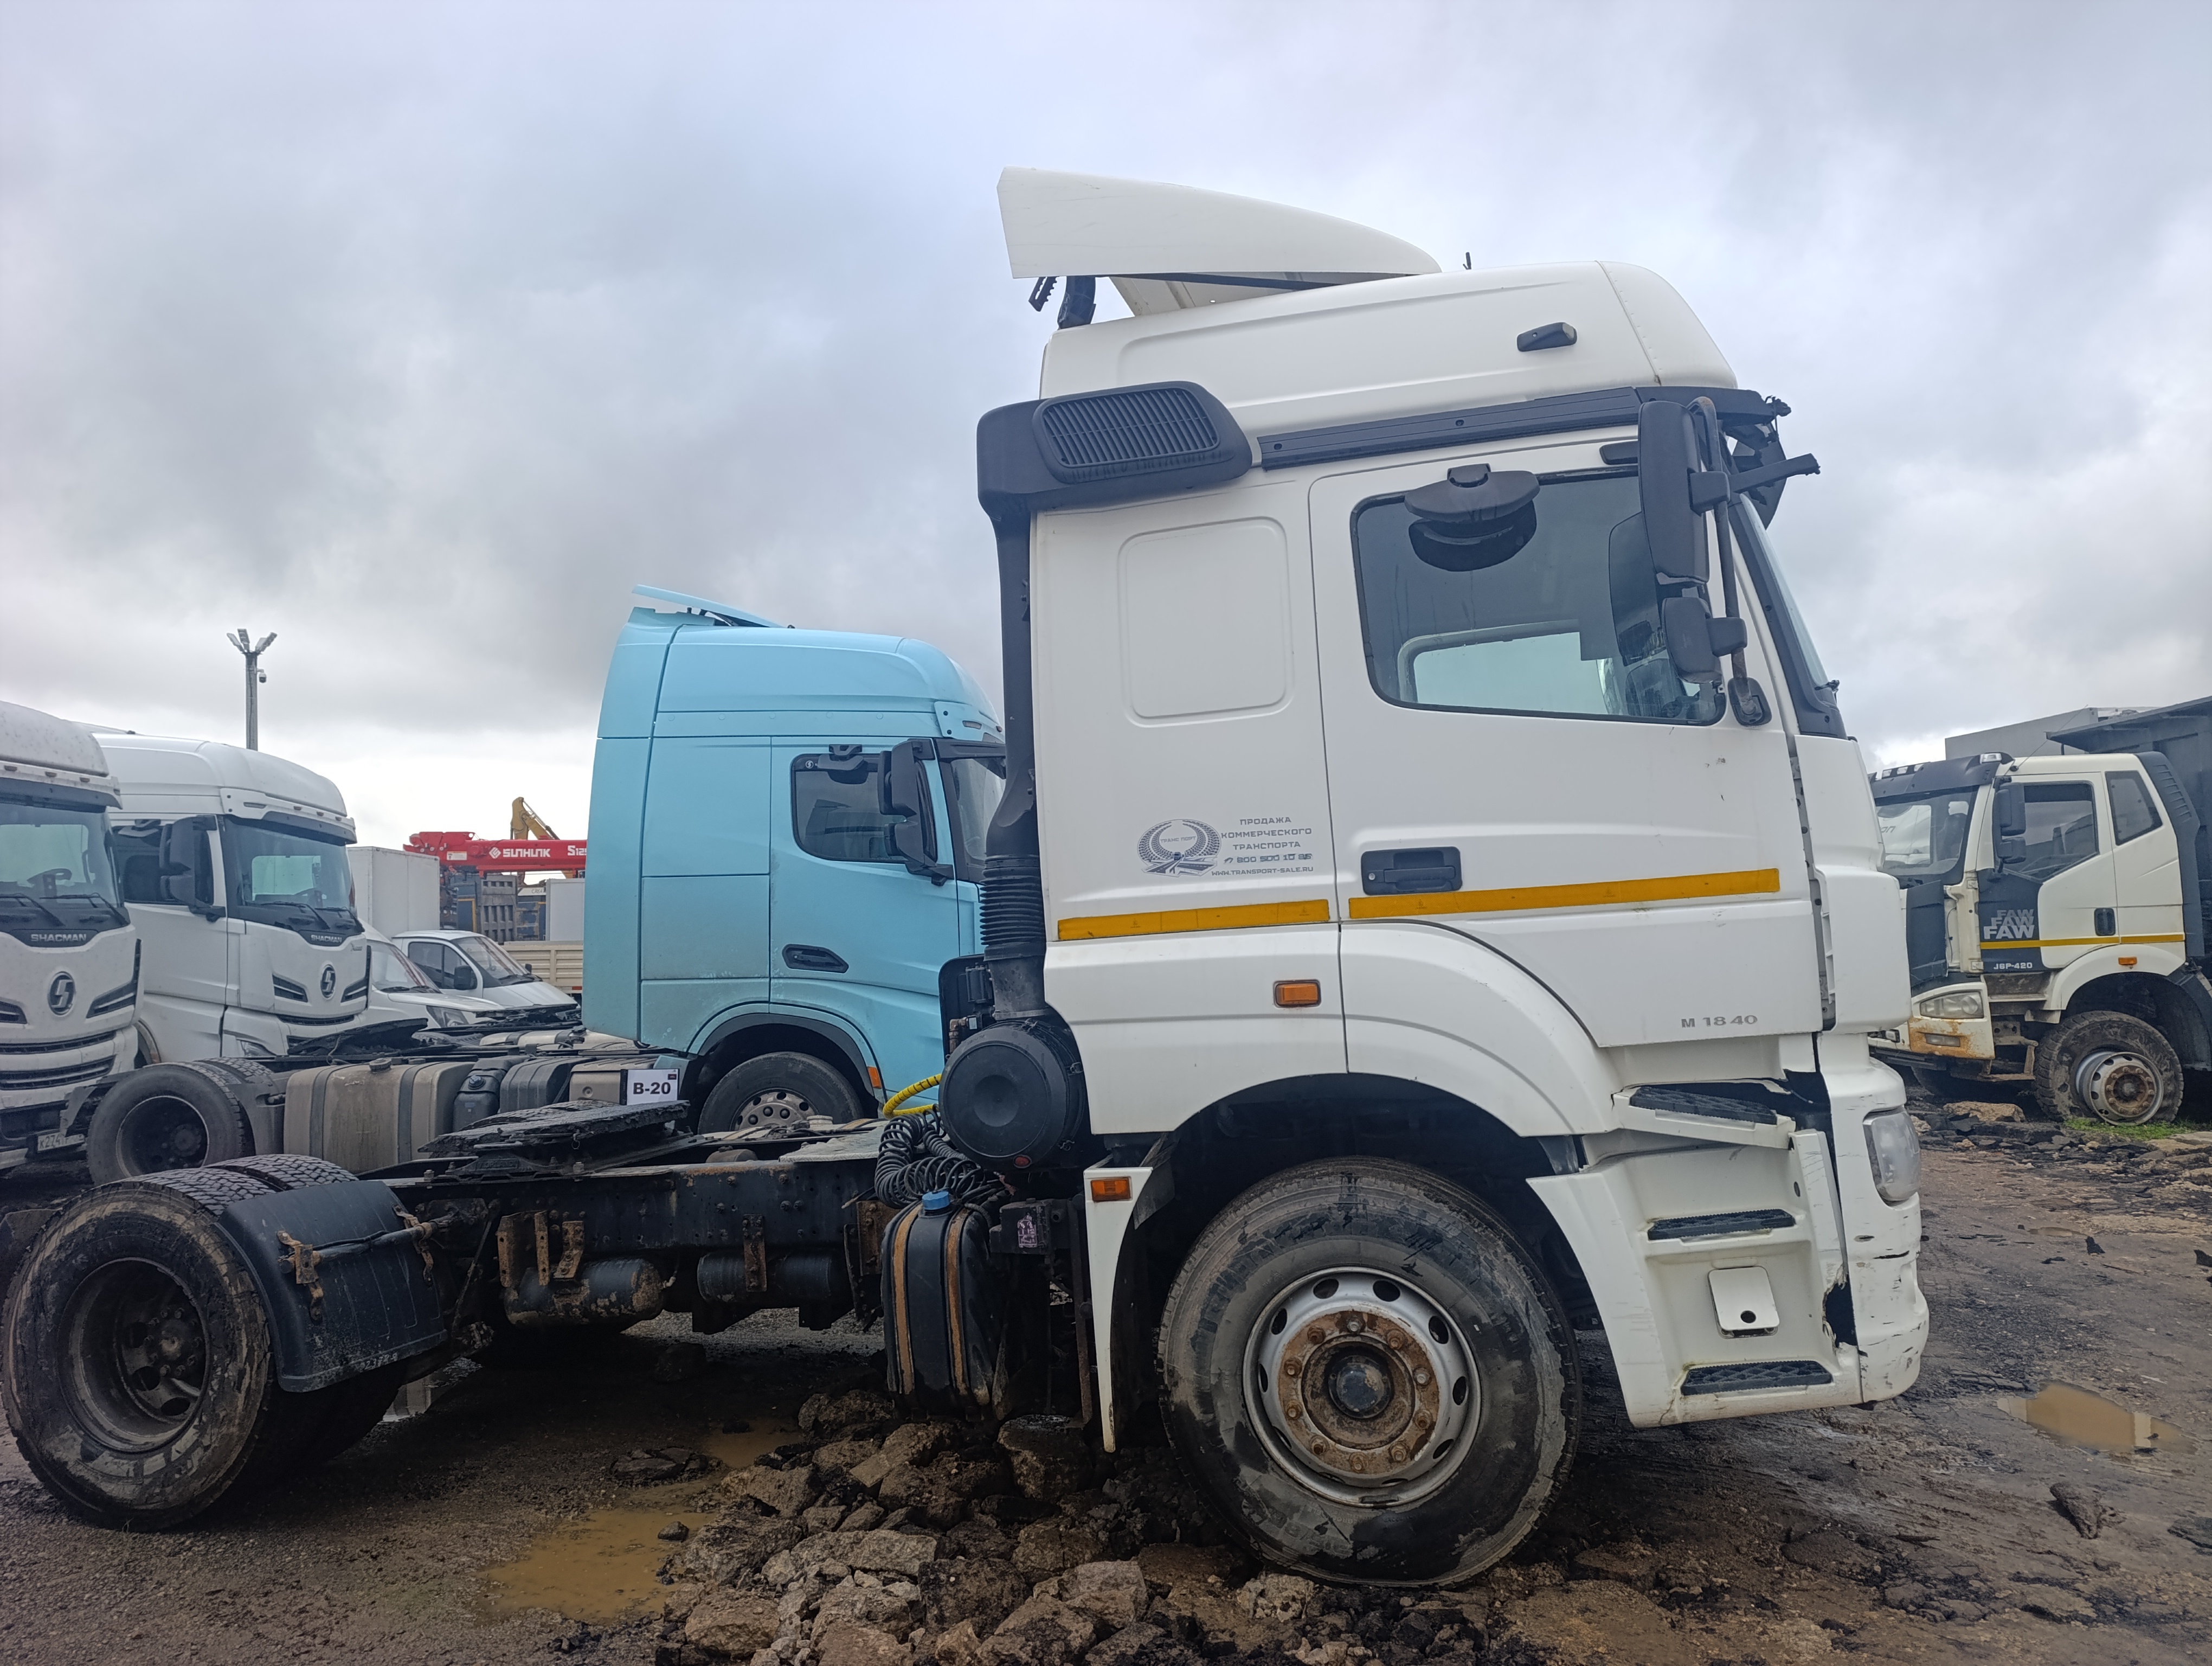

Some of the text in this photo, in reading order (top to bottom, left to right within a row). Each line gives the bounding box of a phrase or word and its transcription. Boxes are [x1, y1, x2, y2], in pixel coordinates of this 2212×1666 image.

[1240, 817, 1291, 825] ПРОДАЖА
[1221, 828, 1312, 839] КОММЕРЧЕСКОГО
[1233, 841, 1301, 850] ТРАНСПОРТА
[1211, 867, 1314, 875] WWW.TRANSPORT-SALE.RU
[1997, 909, 2034, 918] FAW
[1991, 916, 2034, 927] FAW
[1983, 925, 2035, 939] FAW
[31, 933, 86, 942] SHACMAN
[311, 934, 342, 943] SHACMAN
[1681, 1018, 1695, 1028] M
[633, 1082, 671, 1094] B-20
